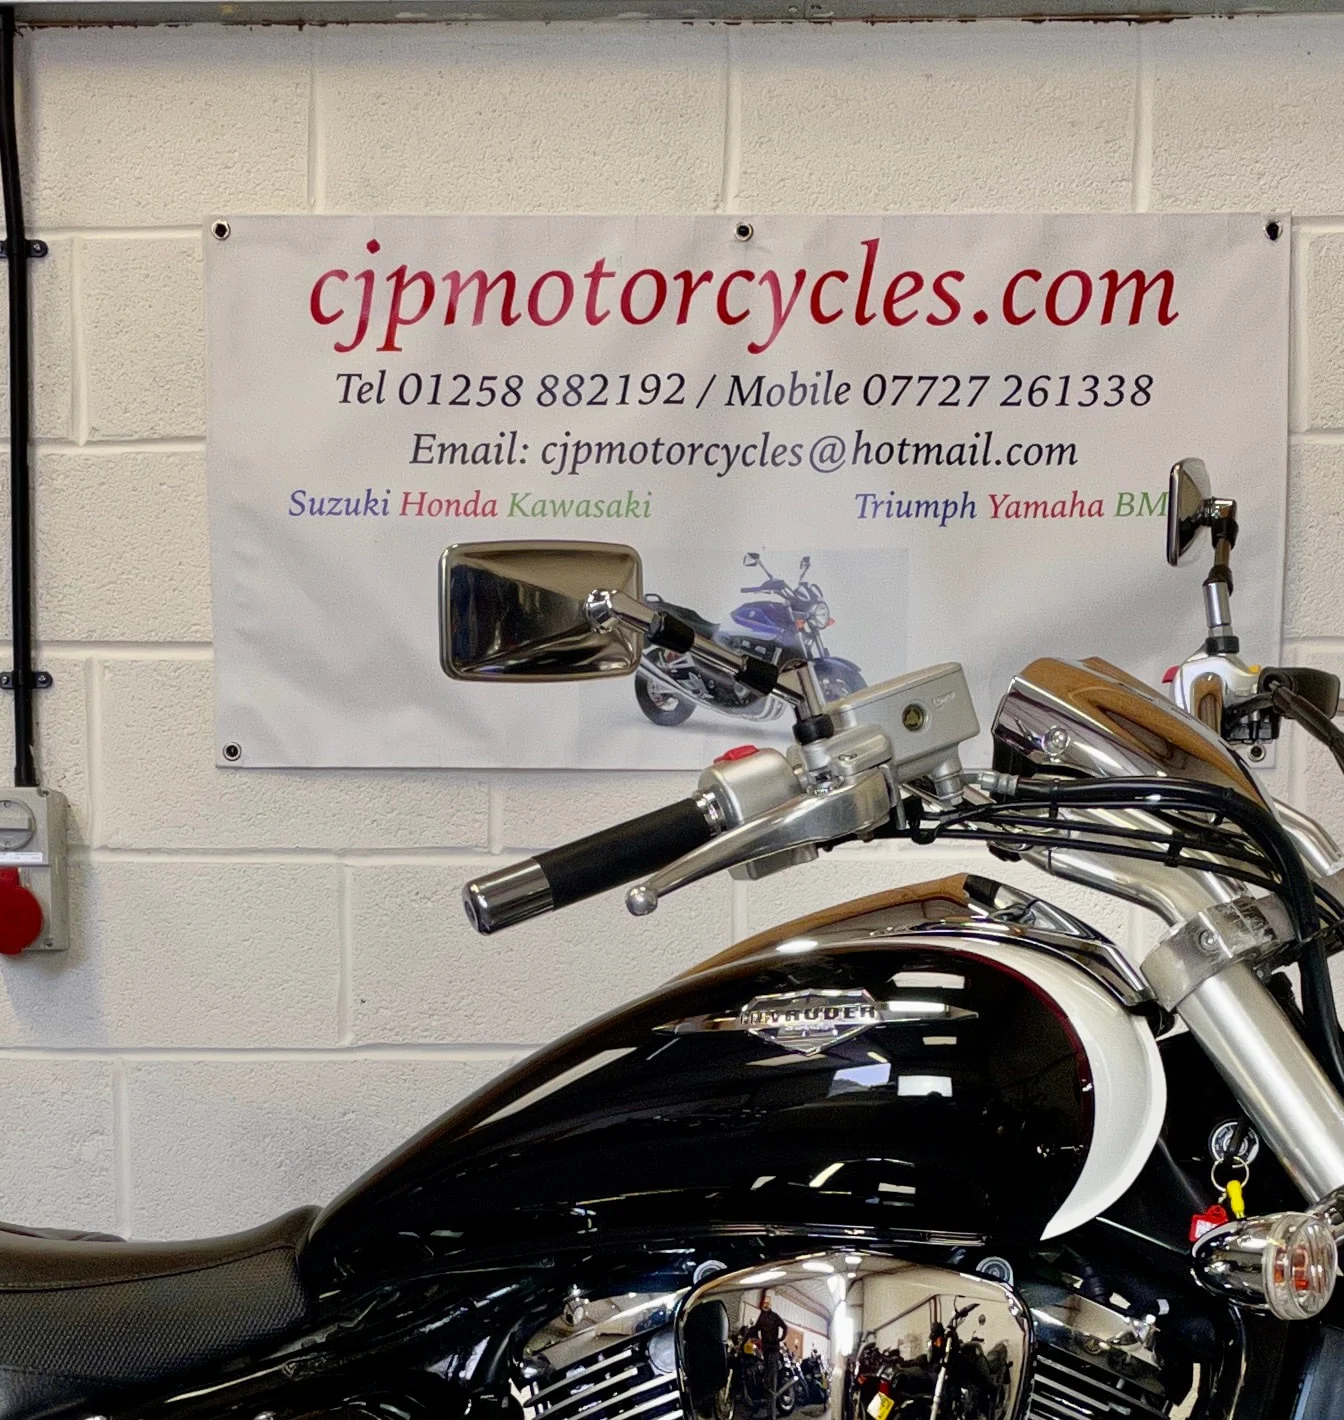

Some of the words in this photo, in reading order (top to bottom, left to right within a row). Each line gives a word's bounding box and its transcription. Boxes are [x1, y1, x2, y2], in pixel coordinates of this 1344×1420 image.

[309, 238, 1180, 354] cjpmotorcycles.com
[335, 369, 386, 405] Tel
[397, 373, 525, 408] 01258
[536, 372, 686, 408] 882192
[695, 373, 718, 410] /
[723, 369, 852, 407] Mobile
[862, 372, 991, 408] 07727
[999, 373, 1154, 408] 261338
[408, 430, 530, 466] Email:
[540, 429, 1079, 477] cjpmotorcycles@hotmail.com
[288, 488, 392, 518] Suzuki
[398, 490, 499, 518] Honda
[506, 490, 653, 519] Kawasaki
[854, 490, 978, 527] Triumph
[987, 490, 1105, 519] Yamaha
[1114, 491, 1169, 517] BM
